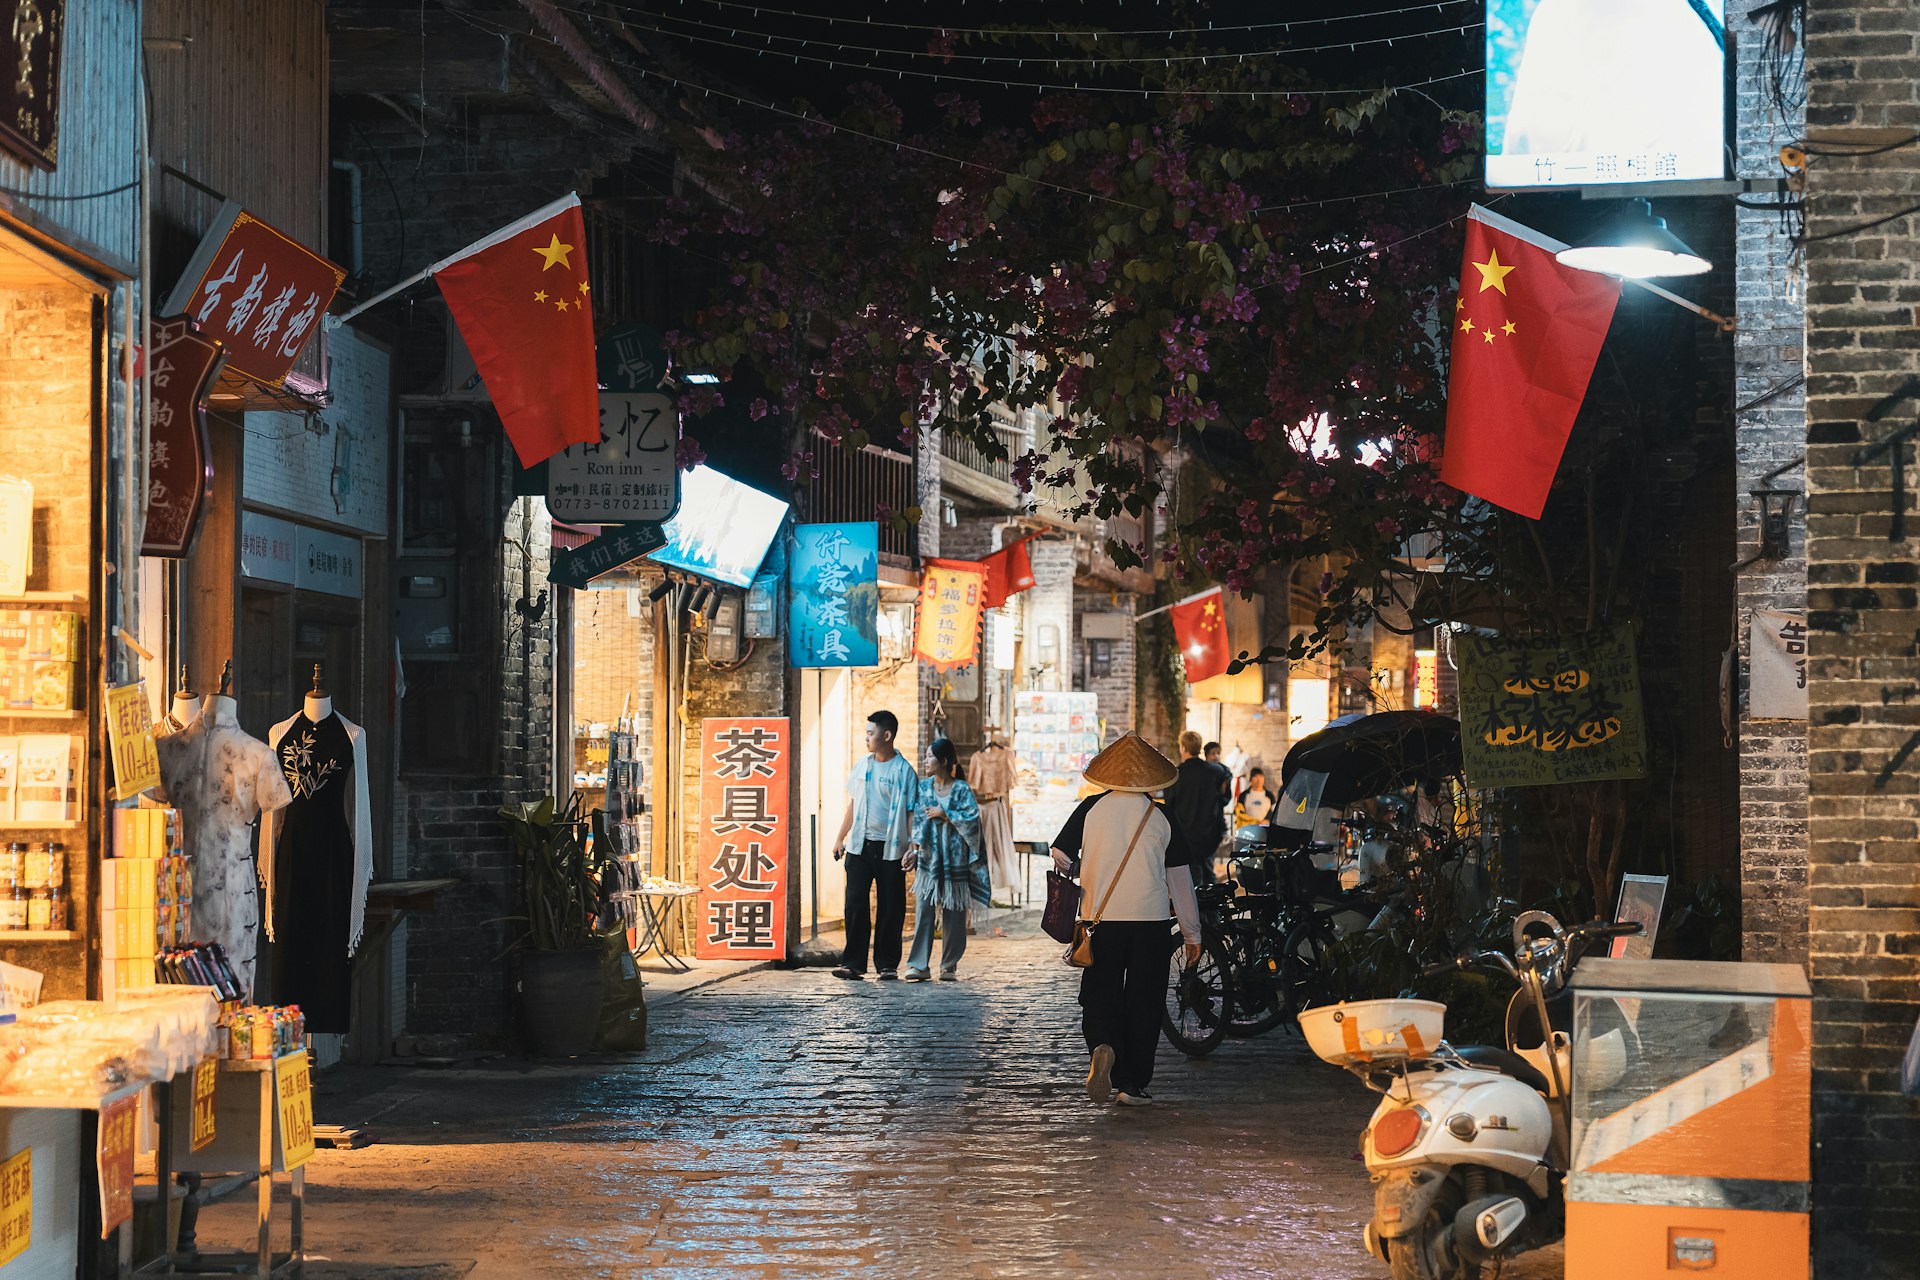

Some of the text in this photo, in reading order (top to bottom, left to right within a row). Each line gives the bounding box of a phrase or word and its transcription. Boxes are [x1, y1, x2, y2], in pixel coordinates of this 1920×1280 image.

[586, 461, 643, 475] Ron inn
[554, 483, 670, 497] 咖啡 民宿 定制旅行
[553, 498, 670, 511] 0773-8702111
[568, 526, 659, 577] 我们在这
[706, 727, 780, 950] 茶具处理
